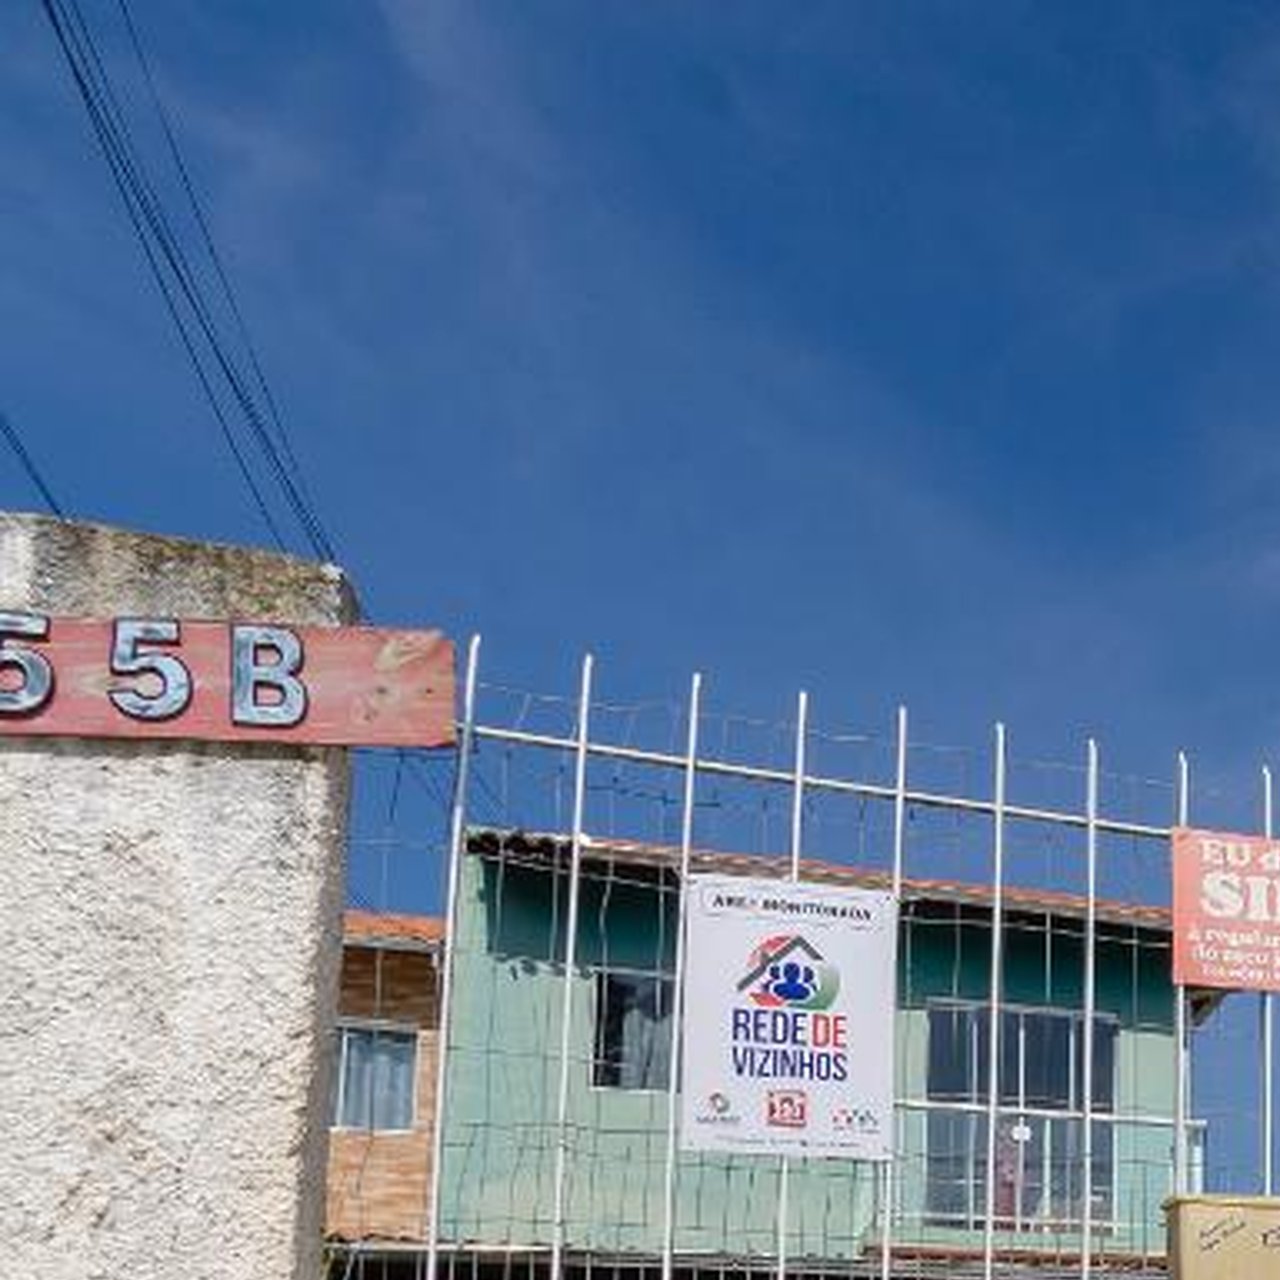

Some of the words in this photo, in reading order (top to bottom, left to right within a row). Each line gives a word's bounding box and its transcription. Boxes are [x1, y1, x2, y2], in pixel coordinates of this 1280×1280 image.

[1202, 839, 1252, 868] EU
[731, 1008, 808, 1047] REDE
[811, 1013, 848, 1049] DE
[731, 1048, 849, 1082] VIZINHOS
